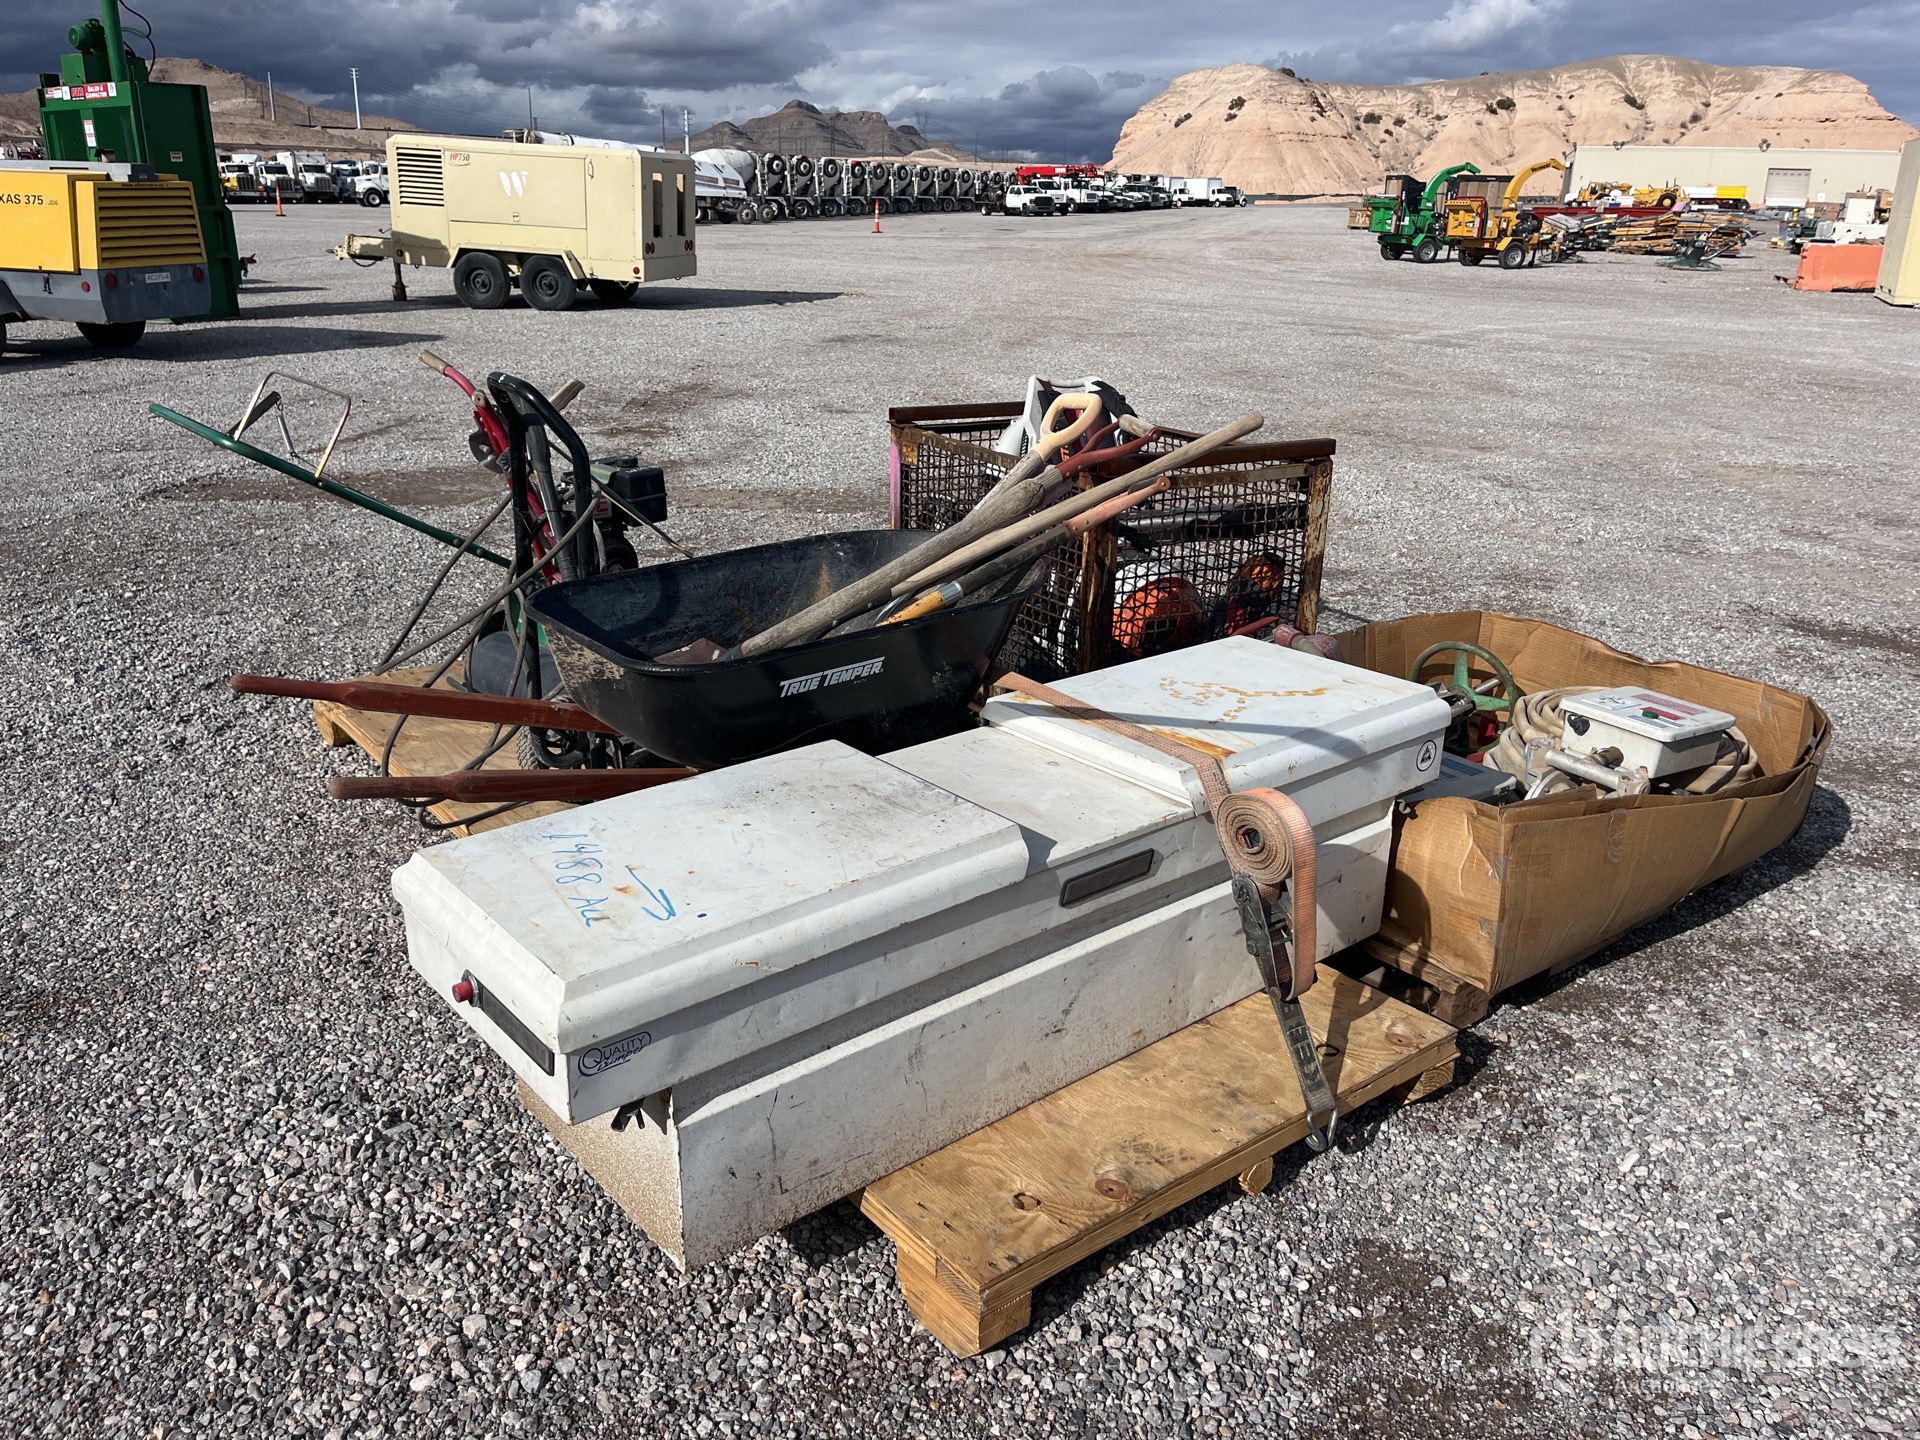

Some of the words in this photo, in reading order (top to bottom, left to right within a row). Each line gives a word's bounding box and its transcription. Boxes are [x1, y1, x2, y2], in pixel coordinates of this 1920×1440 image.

[449, 152, 471, 162] HP750
[24, 194, 44, 206] 375
[779, 671, 824, 698] TRUE
[823, 655, 886, 687] TEMPER
[582, 1034, 646, 1069] QUALITY
